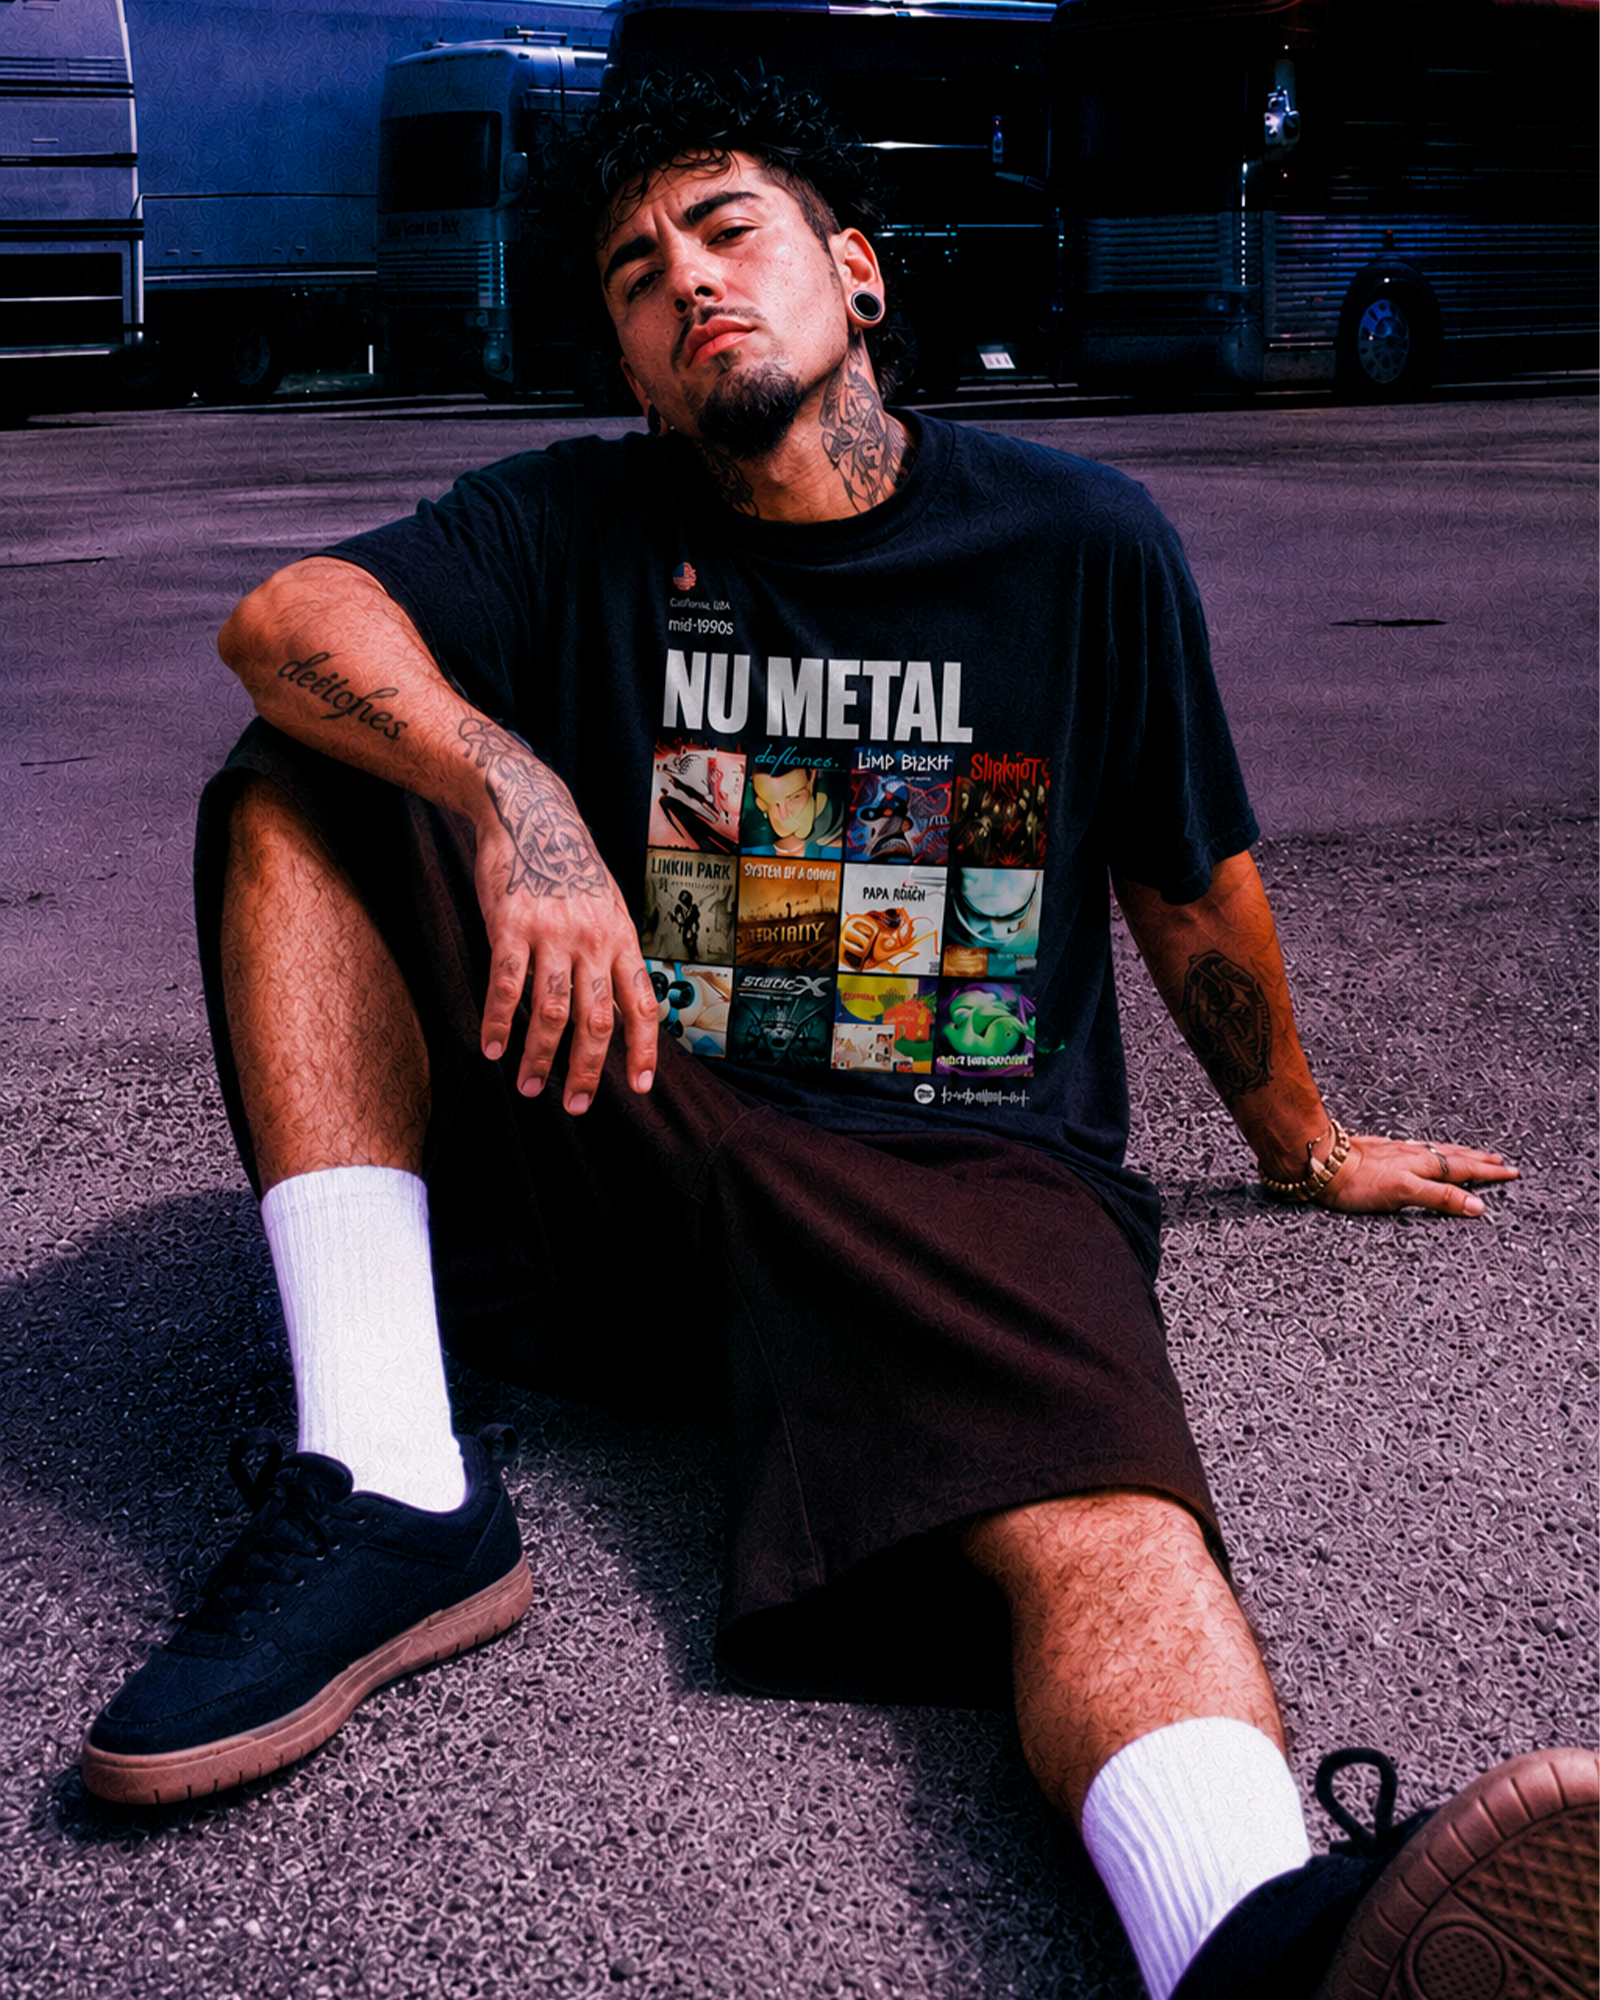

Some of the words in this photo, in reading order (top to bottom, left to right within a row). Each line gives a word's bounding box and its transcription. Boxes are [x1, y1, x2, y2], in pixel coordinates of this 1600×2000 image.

[668, 616, 734, 636] mid-1990s
[663, 648, 751, 734] NU
[766, 655, 974, 744] METAL
[651, 857, 693, 878] LINKIN
[696, 861, 731, 880] PARK
[863, 886, 890, 900] PAPA
